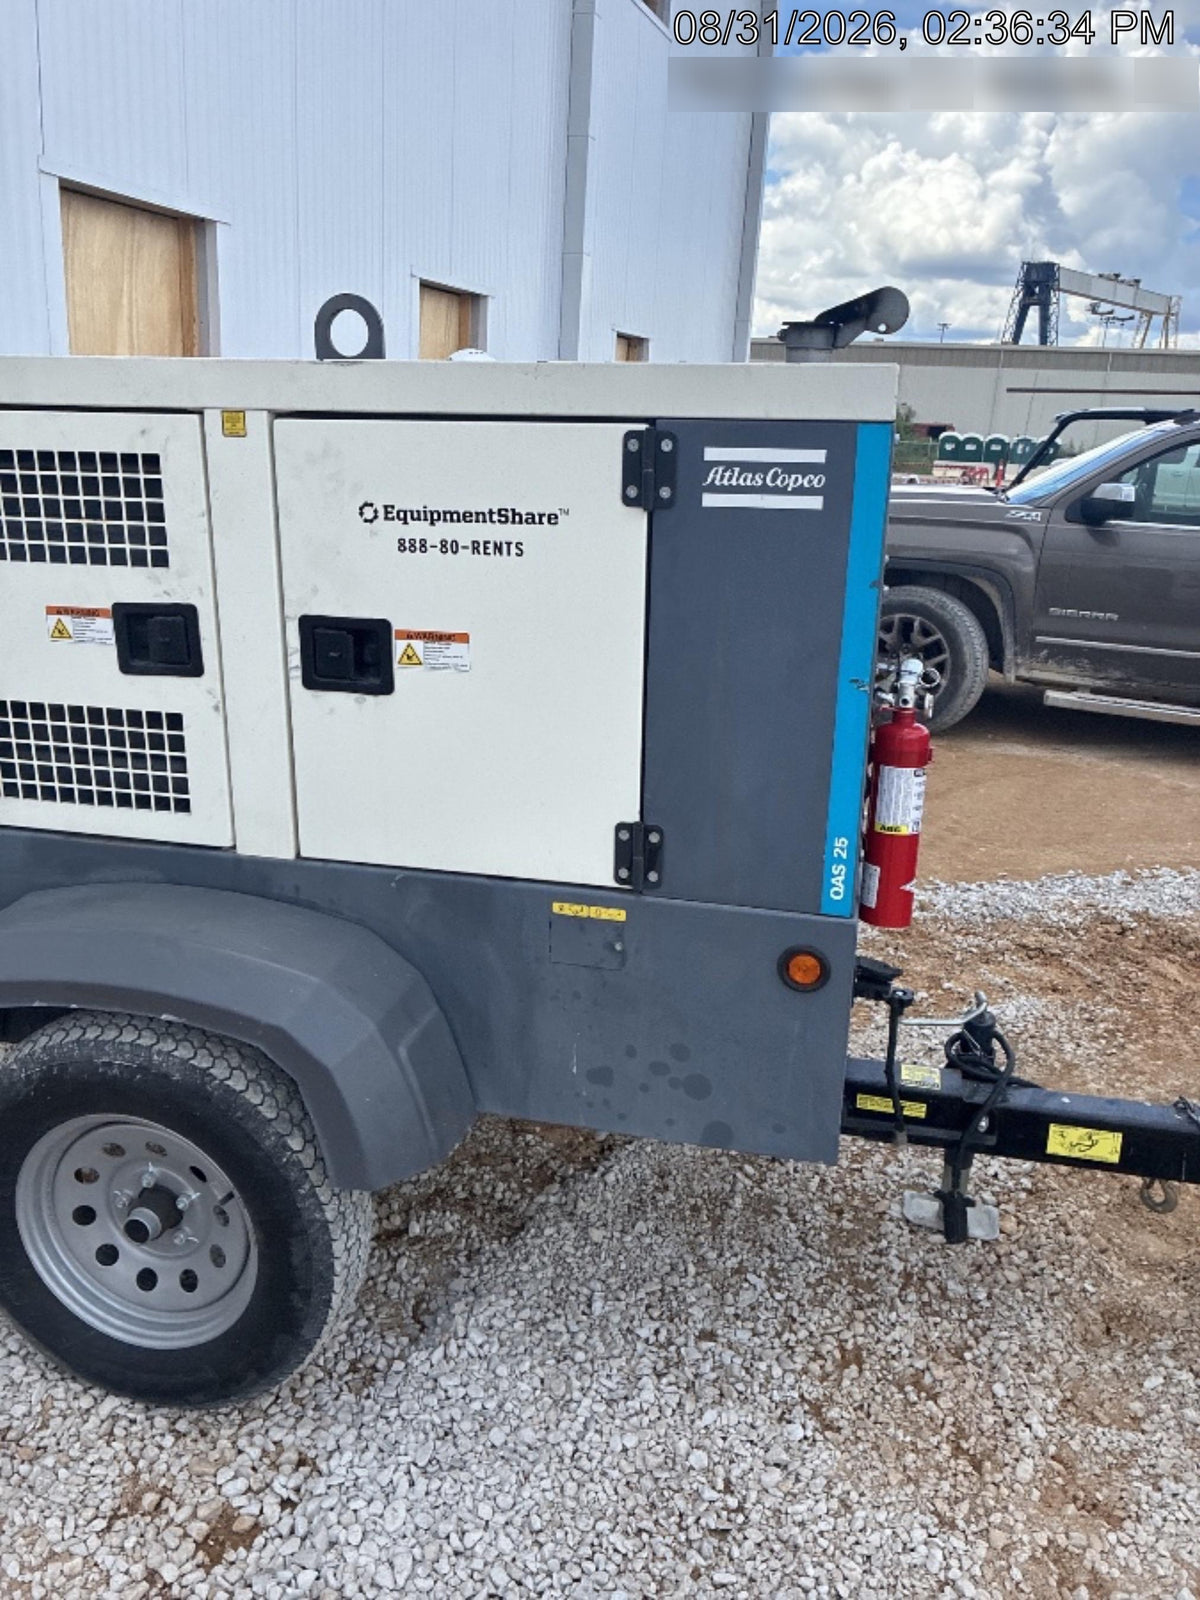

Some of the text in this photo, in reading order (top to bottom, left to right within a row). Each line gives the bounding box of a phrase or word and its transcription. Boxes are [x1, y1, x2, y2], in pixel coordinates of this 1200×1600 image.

[702, 465, 826, 491] Atlas Copco
[397, 538, 524, 557] 888-80-RENTS
[833, 837, 848, 859] 25
